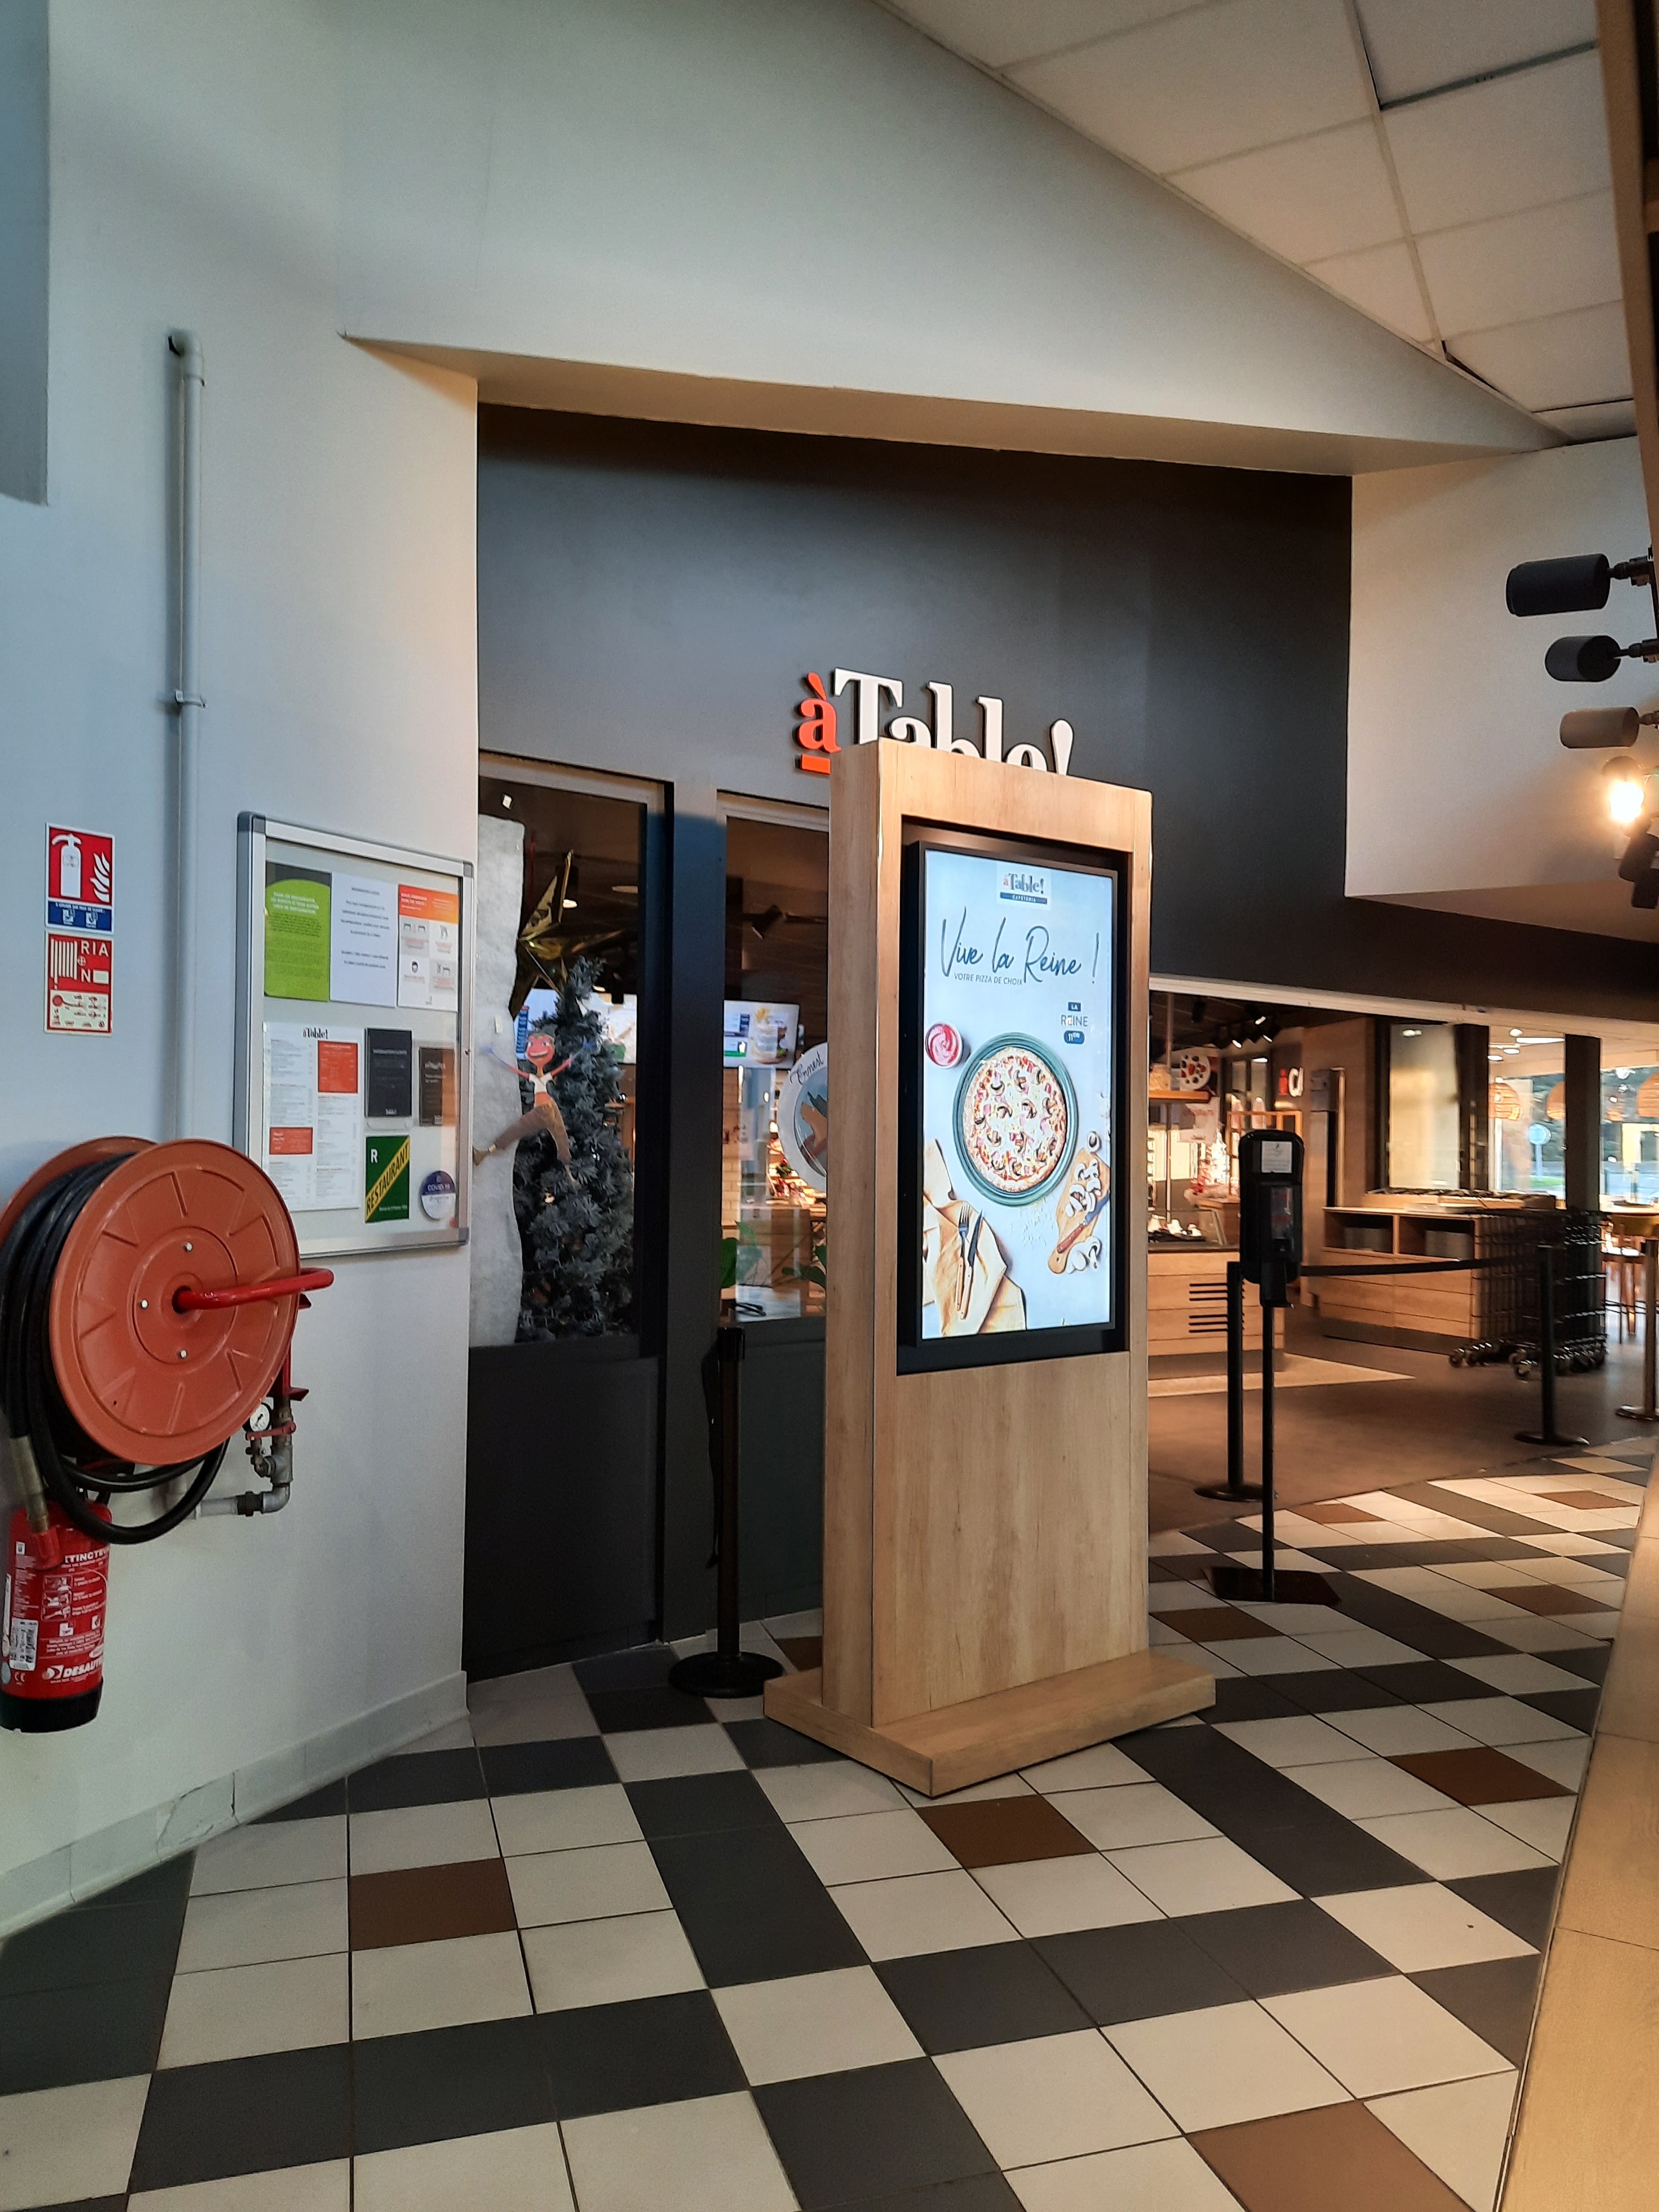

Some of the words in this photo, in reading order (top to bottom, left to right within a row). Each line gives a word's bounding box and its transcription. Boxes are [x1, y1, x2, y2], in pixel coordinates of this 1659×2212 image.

[81, 940, 109, 957] RIA
[940, 906, 983, 977] Vive
[1024, 925, 1082, 984] Reine
[954, 972, 974, 982] VOTRE
[975, 974, 993, 984] PIZZA
[993, 975, 1002, 984] DE
[1003, 977, 1023, 985] CHOIX
[1061, 1014, 1088, 1027] REINE
[371, 1148, 378, 1164] R
[366, 1143, 409, 1216] RESTAURANT
